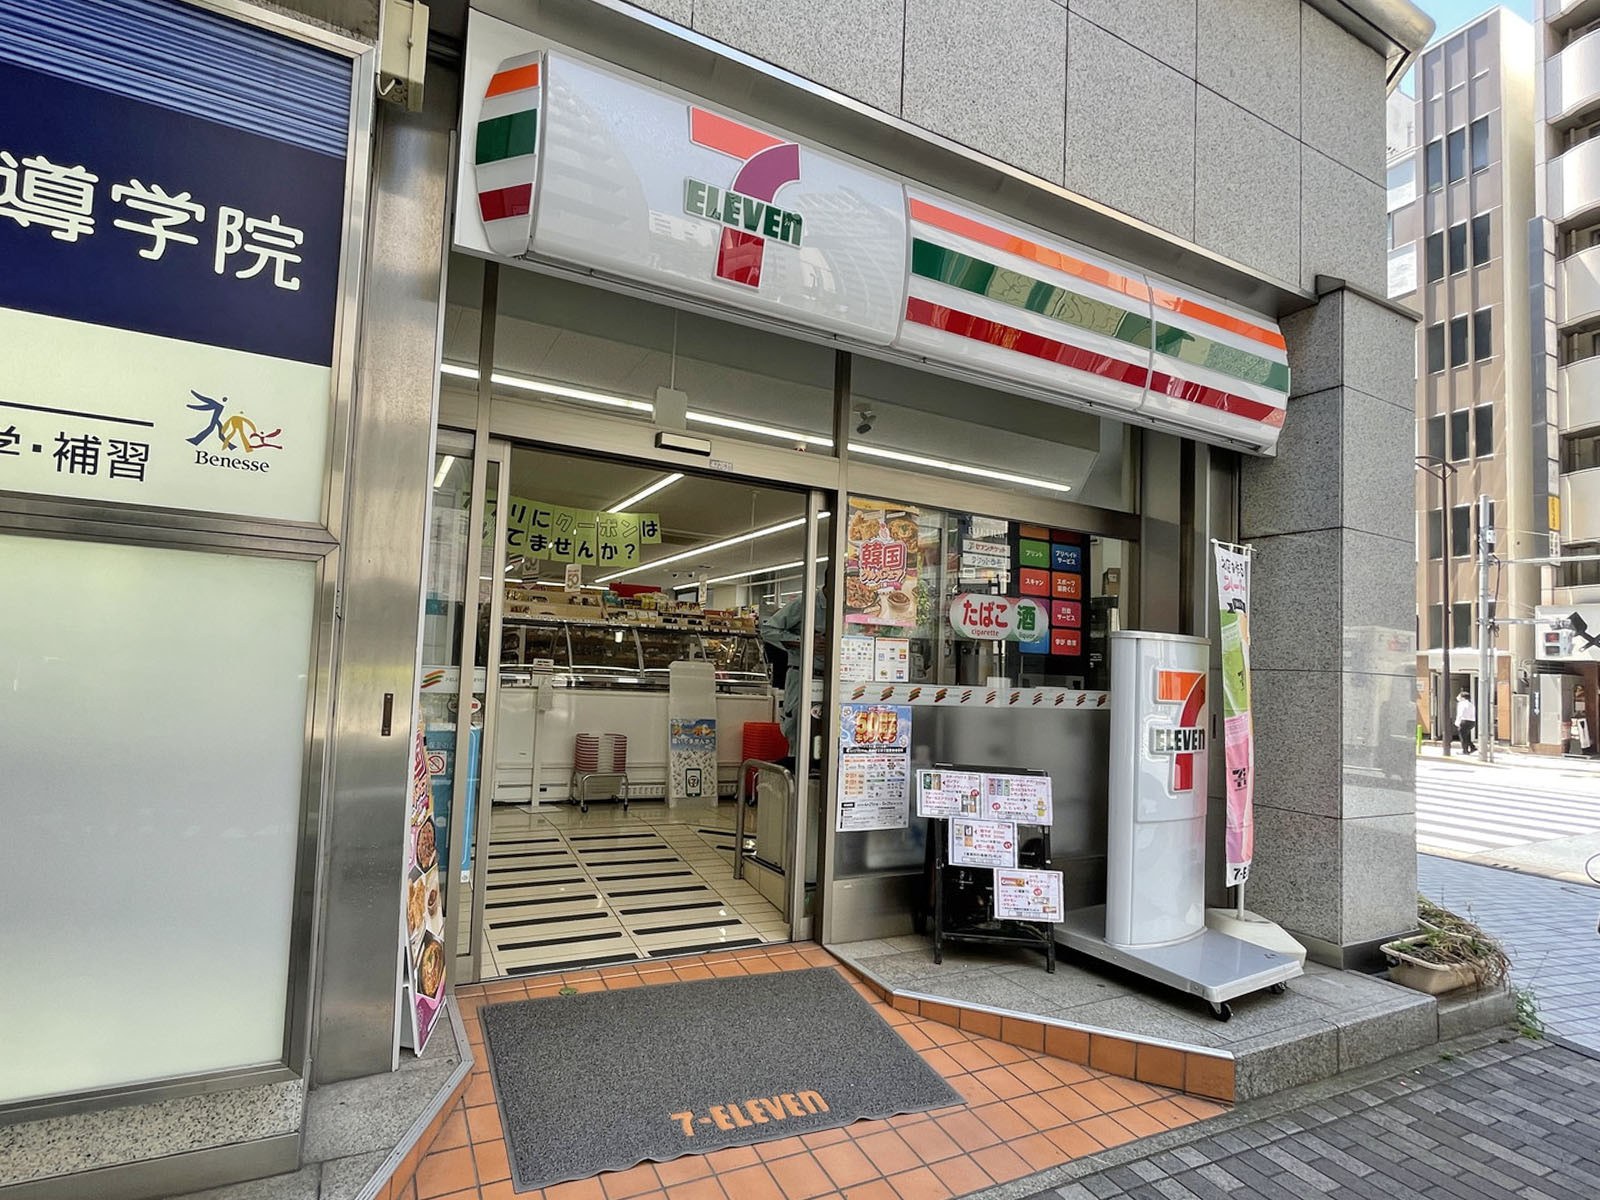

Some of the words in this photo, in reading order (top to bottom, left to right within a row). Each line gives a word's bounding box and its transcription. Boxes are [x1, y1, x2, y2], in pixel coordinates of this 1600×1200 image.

[0, 150, 304, 291] 導学院
[195, 450, 270, 473] Benesse
[861, 542, 903, 568] 韓国
[962, 600, 1008, 628] たばこ
[1017, 605, 1036, 631] 酒
[971, 628, 1000, 637] cigarette
